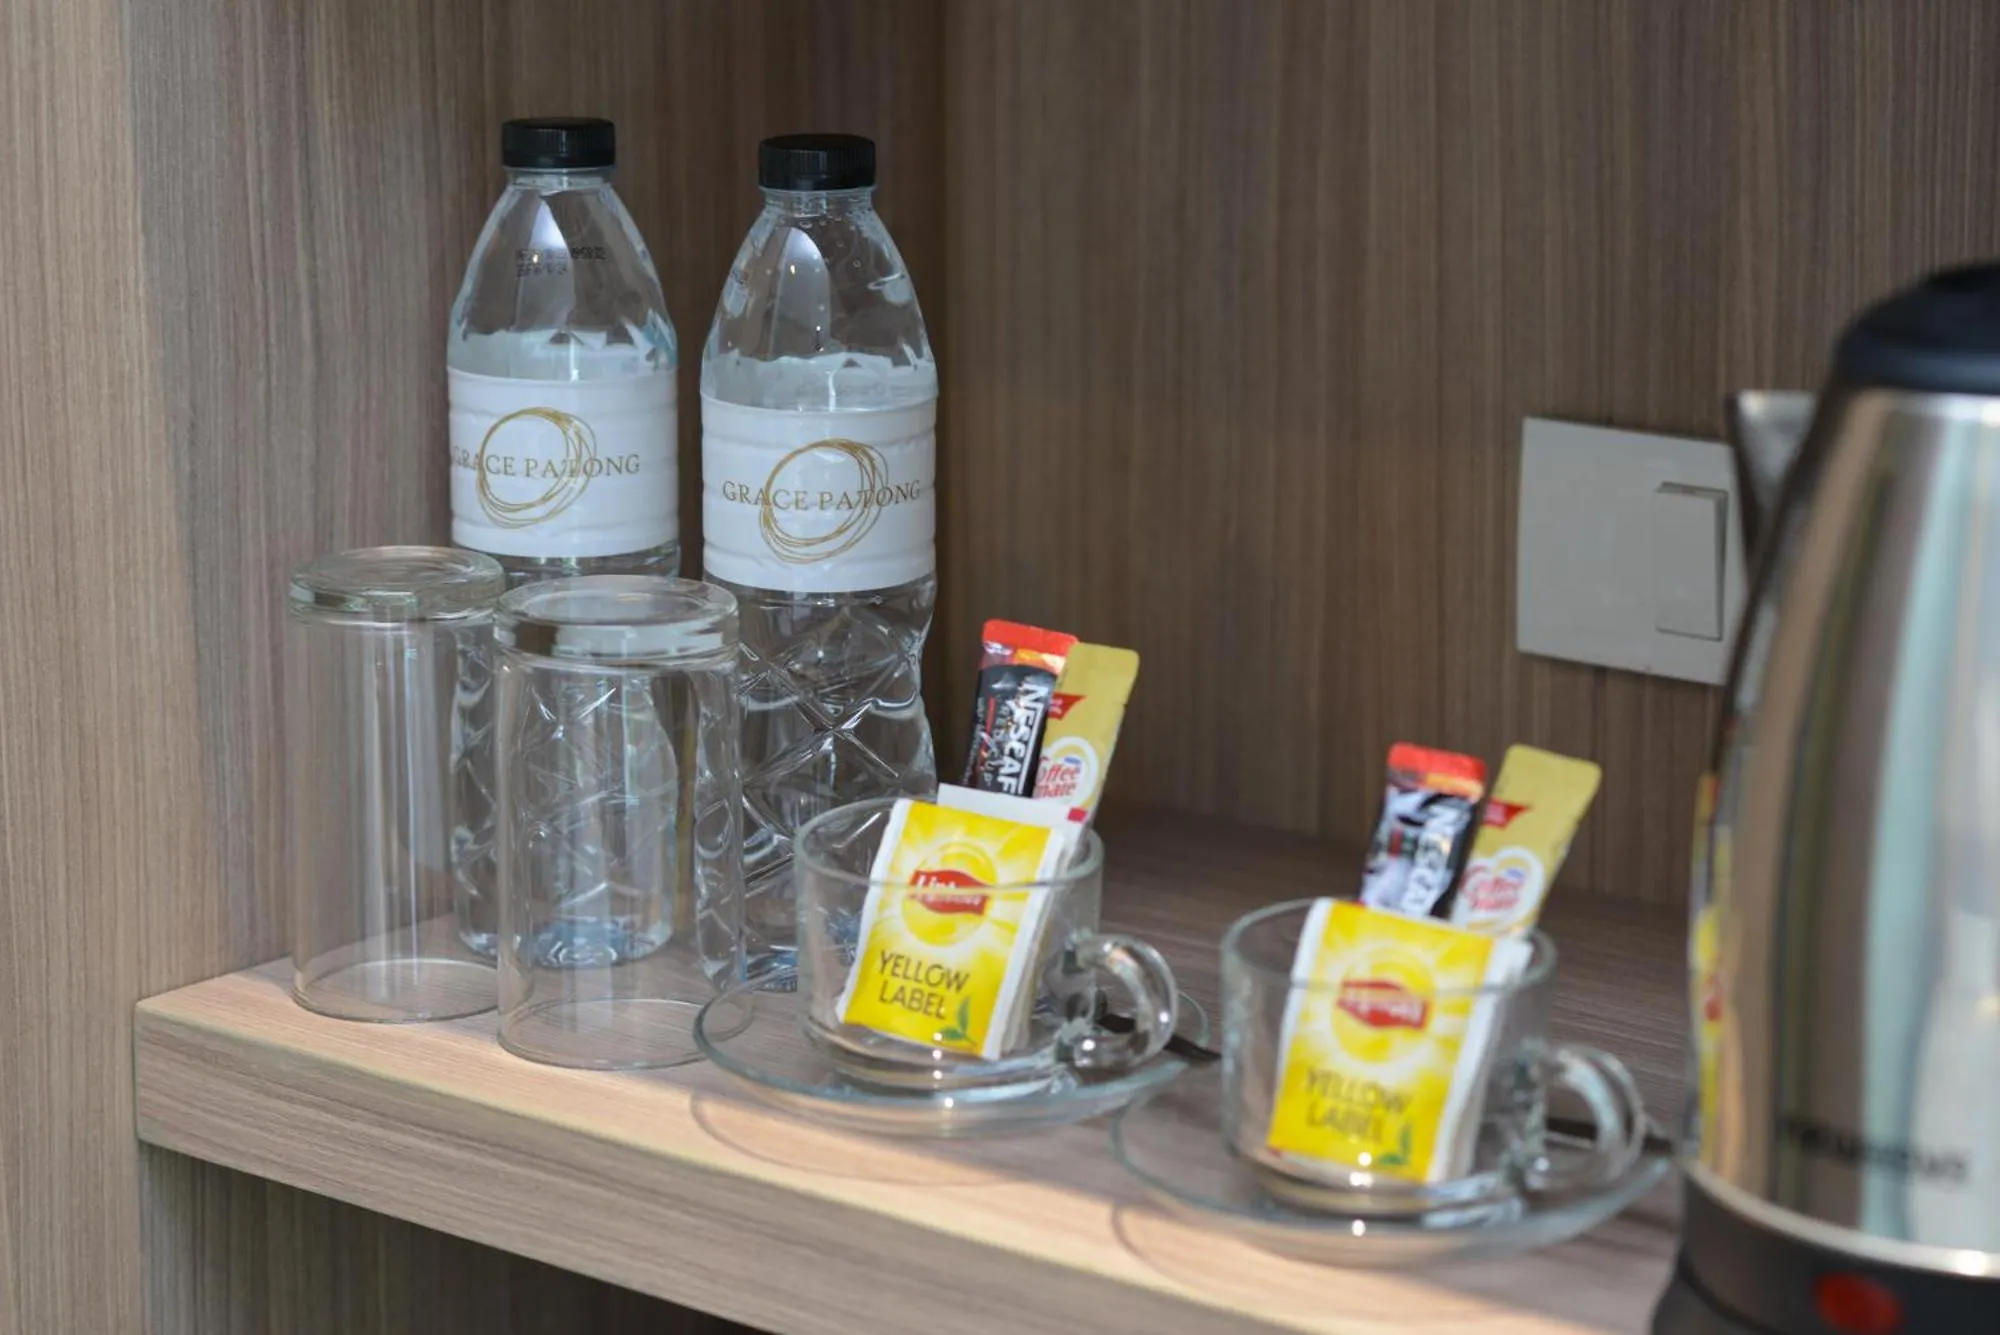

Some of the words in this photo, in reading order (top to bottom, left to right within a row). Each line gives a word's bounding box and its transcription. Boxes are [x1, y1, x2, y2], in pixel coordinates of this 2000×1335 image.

[722, 480, 809, 511] GRACE
[818, 479, 921, 511] PATONG
[997, 680, 1048, 796] NESCAF
[879, 950, 971, 994] YELLOW
[878, 980, 947, 1020] LABEL
